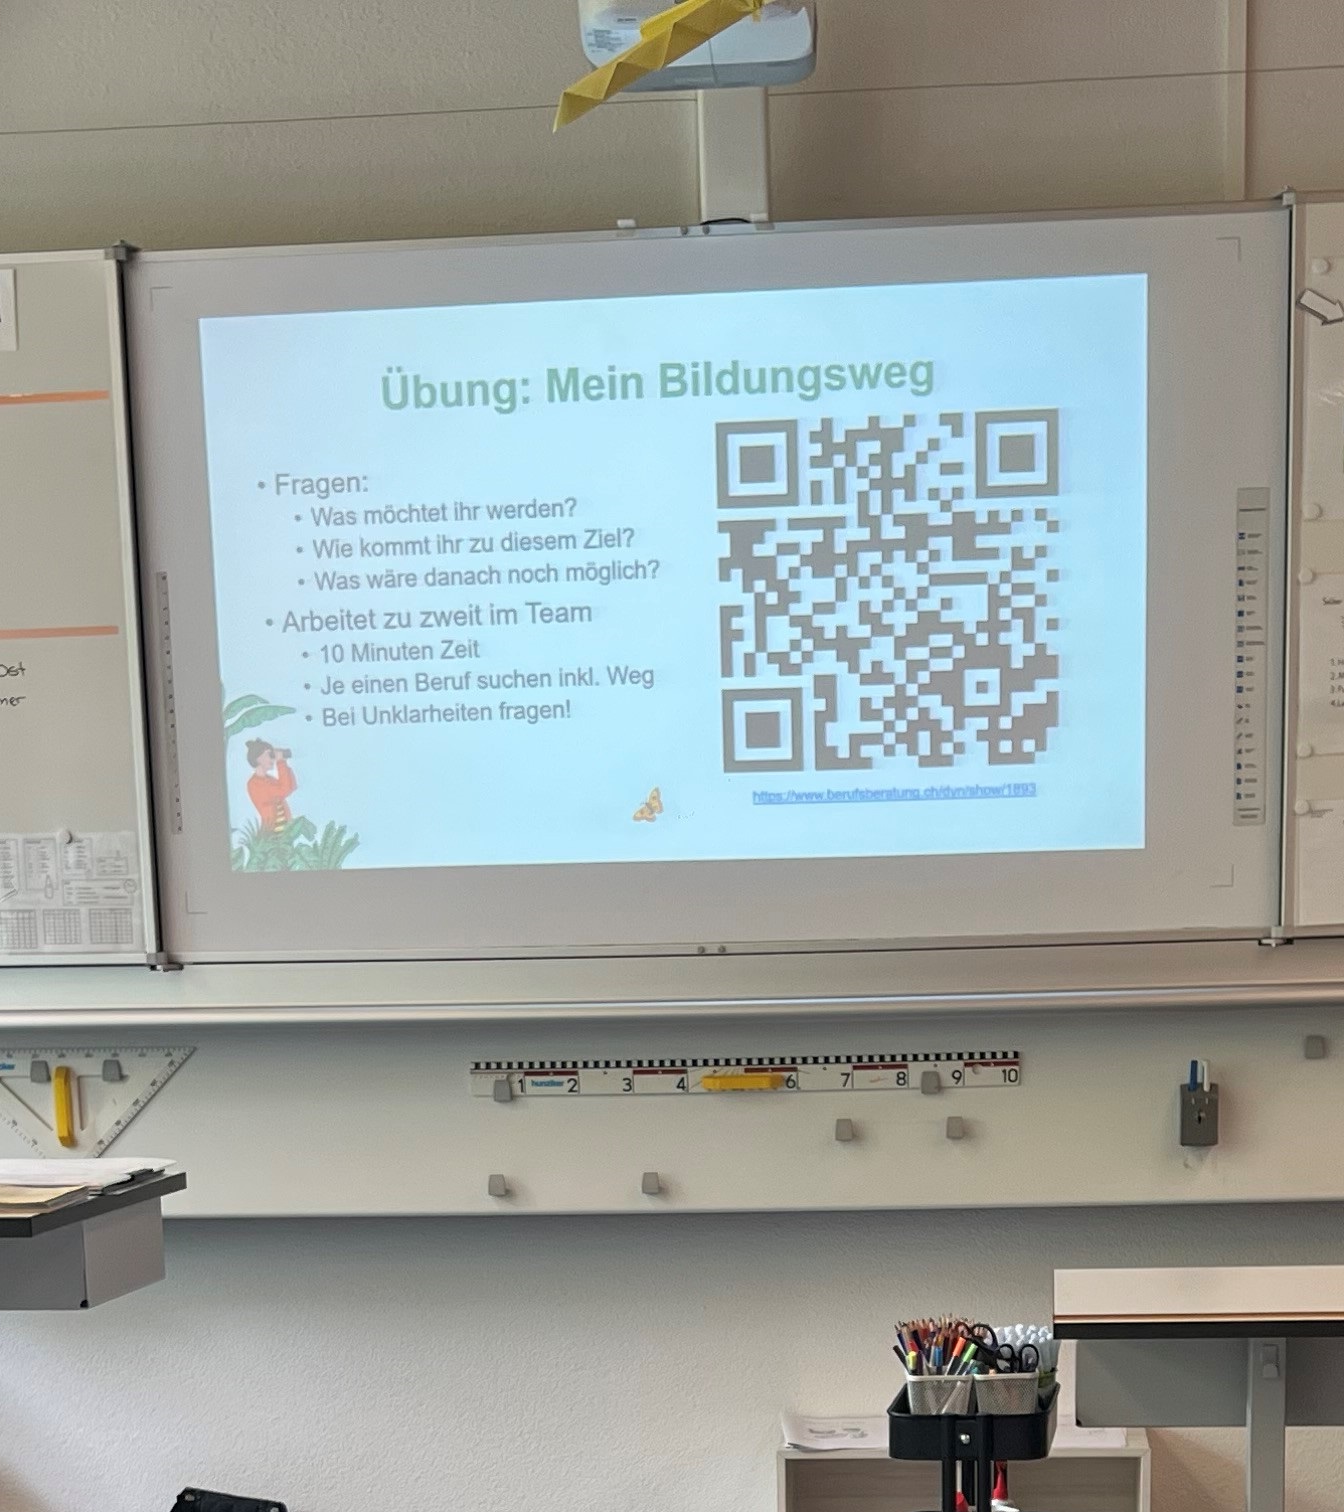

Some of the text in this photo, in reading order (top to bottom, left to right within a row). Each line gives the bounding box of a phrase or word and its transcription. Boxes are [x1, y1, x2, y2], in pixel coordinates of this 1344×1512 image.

[381, 360, 934, 414] Übung: Mein Bildungsweg
[275, 473, 368, 499] Fragen:
[311, 497, 576, 526] Was möchtet ihr werden?
[312, 527, 635, 558] Wie kommt ihr zu diesem Ziel?
[314, 559, 659, 590] Was wäre danach noch möglich?
[282, 602, 592, 633] Arbeitet zu zweit im Team
[320, 640, 481, 663] 10 Minuten Zeit
[321, 666, 655, 695] Je einen Beruf suchen inkl. Weg
[322, 699, 571, 726] Bei Unklarheiten fragen!
[567, 1077, 578, 1093] 2
[622, 1078, 633, 1094] 3
[675, 1076, 687, 1092] 4
[785, 1073, 796, 1089] 6
[840, 1072, 851, 1088] 7
[895, 1071, 907, 1087] 8
[951, 1069, 962, 1086] 9
[1001, 1067, 1019, 1084] 10
